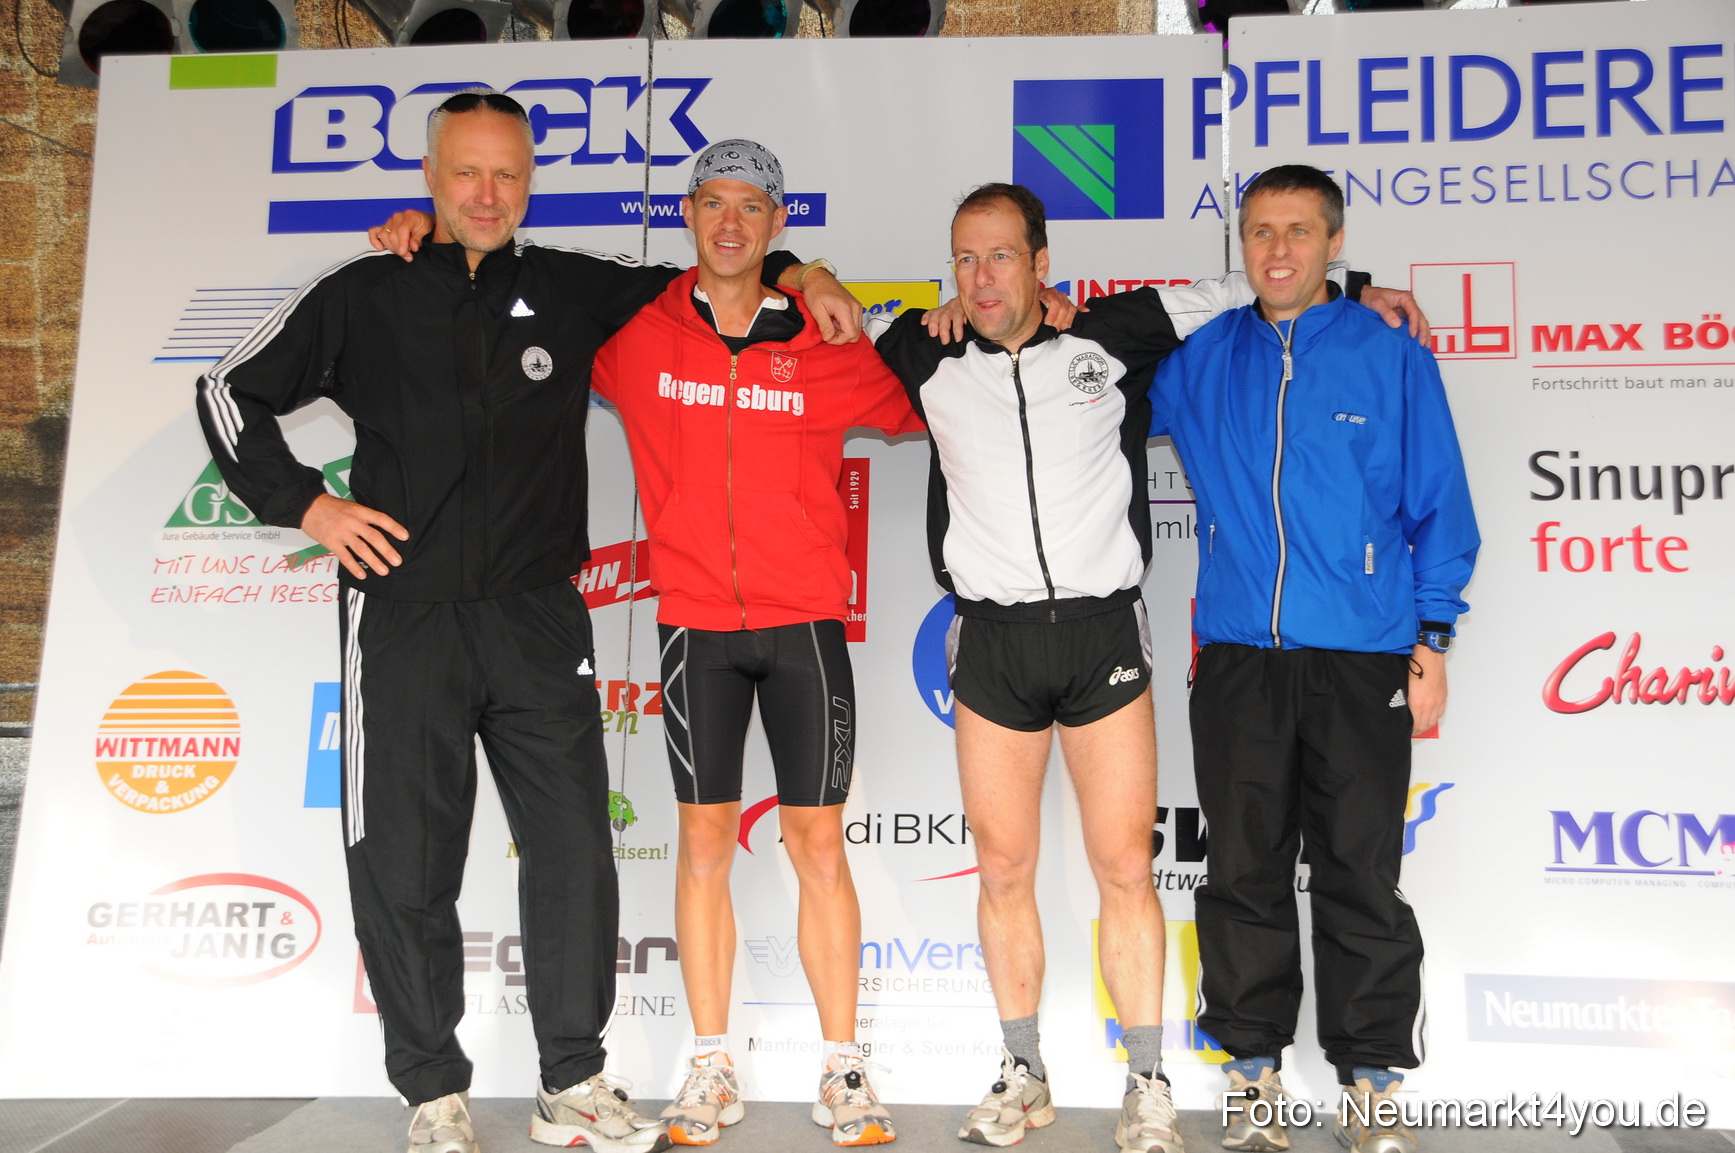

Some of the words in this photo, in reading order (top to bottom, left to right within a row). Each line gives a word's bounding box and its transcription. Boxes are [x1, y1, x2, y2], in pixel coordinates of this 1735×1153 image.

[1192, 44, 1735, 160] PFLEIDERE
[1531, 323, 1644, 353] MAX
[1663, 314, 1735, 351] BÖ
[1532, 377, 1619, 391] Fortschritt
[1625, 377, 1664, 390] baut
[1671, 379, 1706, 389] man
[658, 372, 726, 406] Regen
[736, 384, 805, 416] sburg
[850, 471, 860, 491] 1929
[1528, 450, 1735, 515] Sinupr
[850, 494, 860, 510] Seit
[162, 532, 180, 541] Jura
[182, 531, 220, 541] Gebäude
[222, 531, 252, 541] Service
[255, 531, 280, 540] GmbH
[1530, 521, 1689, 573] forte
[202, 555, 255, 574] UNS
[271, 584, 340, 602] BESS
[95, 737, 241, 757] WITTMANN
[131, 764, 197, 779] DRUCK
[108, 773, 220, 811] VERPACKUNG
[155, 780, 170, 795] &
[1544, 877, 1574, 885] MICRO
[1578, 877, 1630, 886] COMPUTER
[1634, 879, 1687, 888] MANAGING
[87, 901, 276, 928] GERHART
[280, 911, 294, 926] &
[748, 1037, 821, 1053] Manfred
[902, 1040, 914, 1054] &
[921, 1041, 966, 1055] Sven
